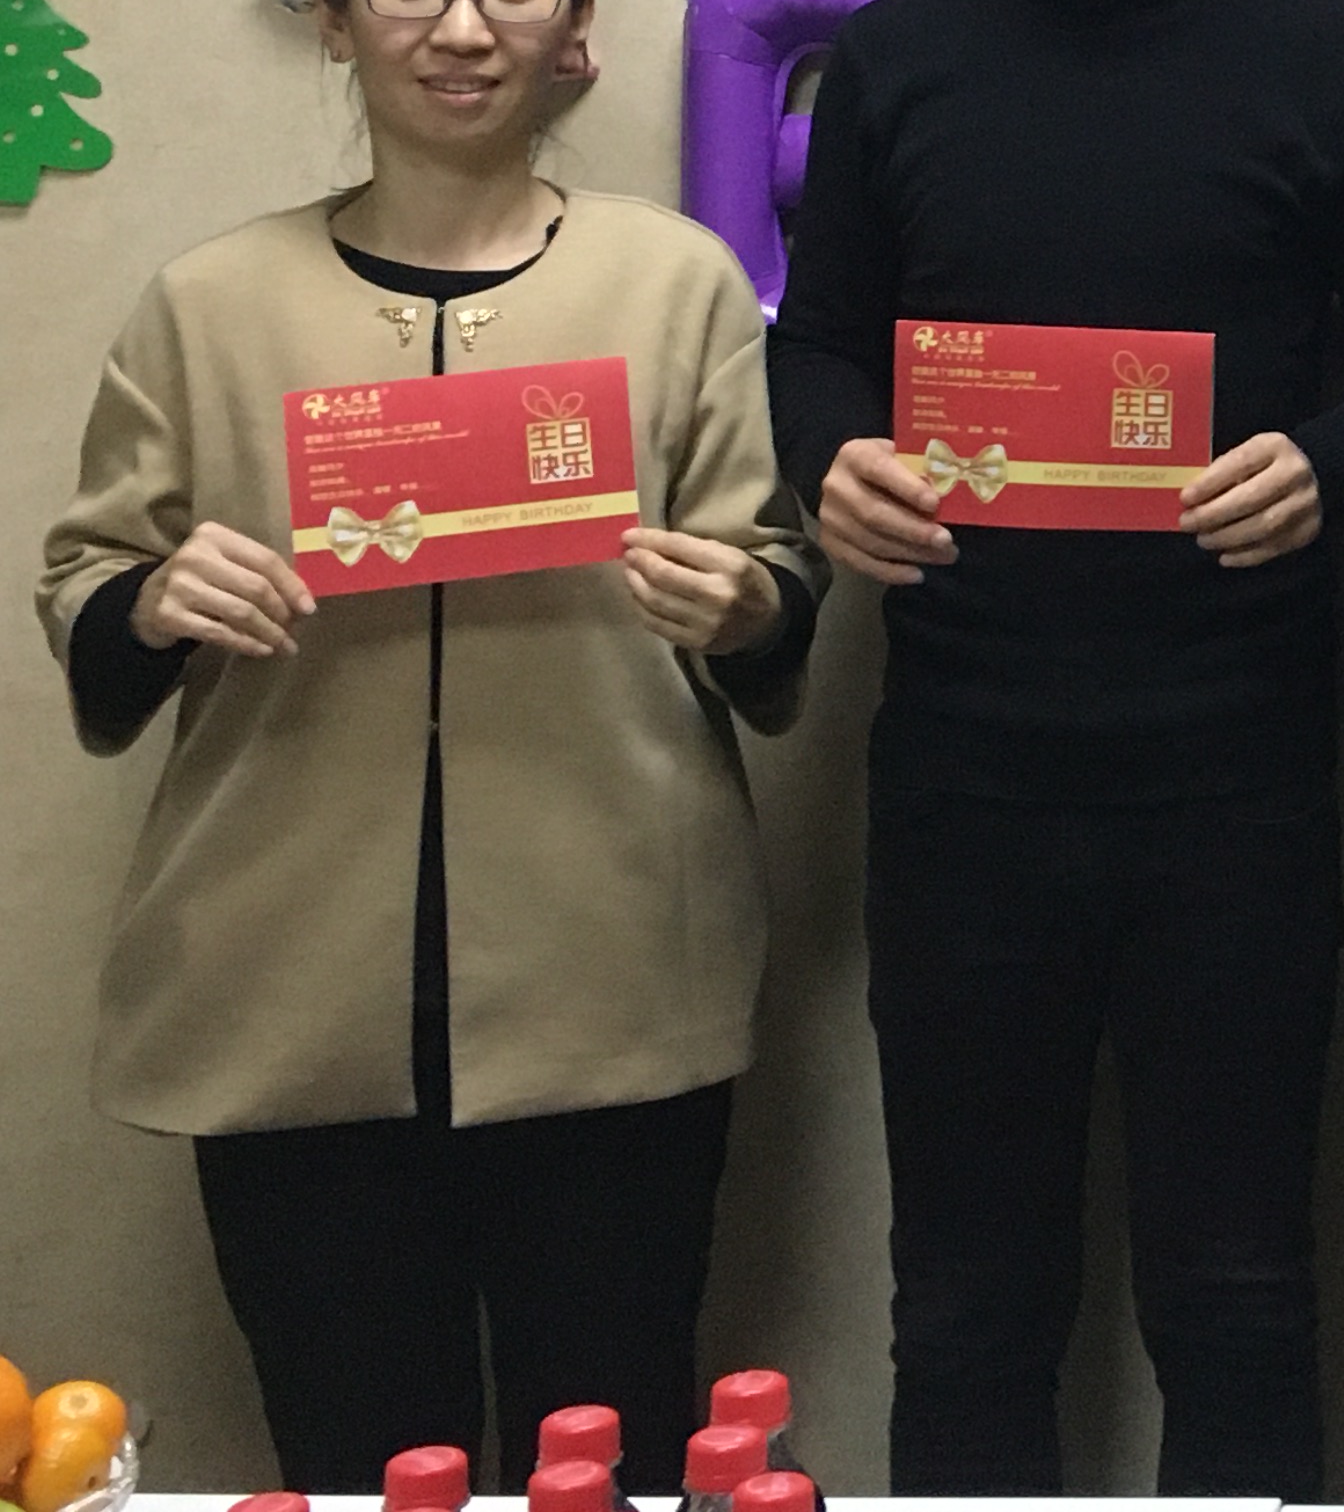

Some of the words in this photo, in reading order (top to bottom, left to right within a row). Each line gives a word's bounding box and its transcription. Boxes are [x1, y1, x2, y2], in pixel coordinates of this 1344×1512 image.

[1115, 391, 1170, 419] 生日
[529, 420, 588, 451] 生日
[1114, 419, 1170, 446] 快乐
[531, 451, 591, 481] 快乐
[1043, 468, 1090, 482] HAPPY
[1098, 469, 1167, 483] BIRTHDAY
[462, 512, 511, 527] HAPPY
[519, 501, 593, 522] BIRTHDAY
